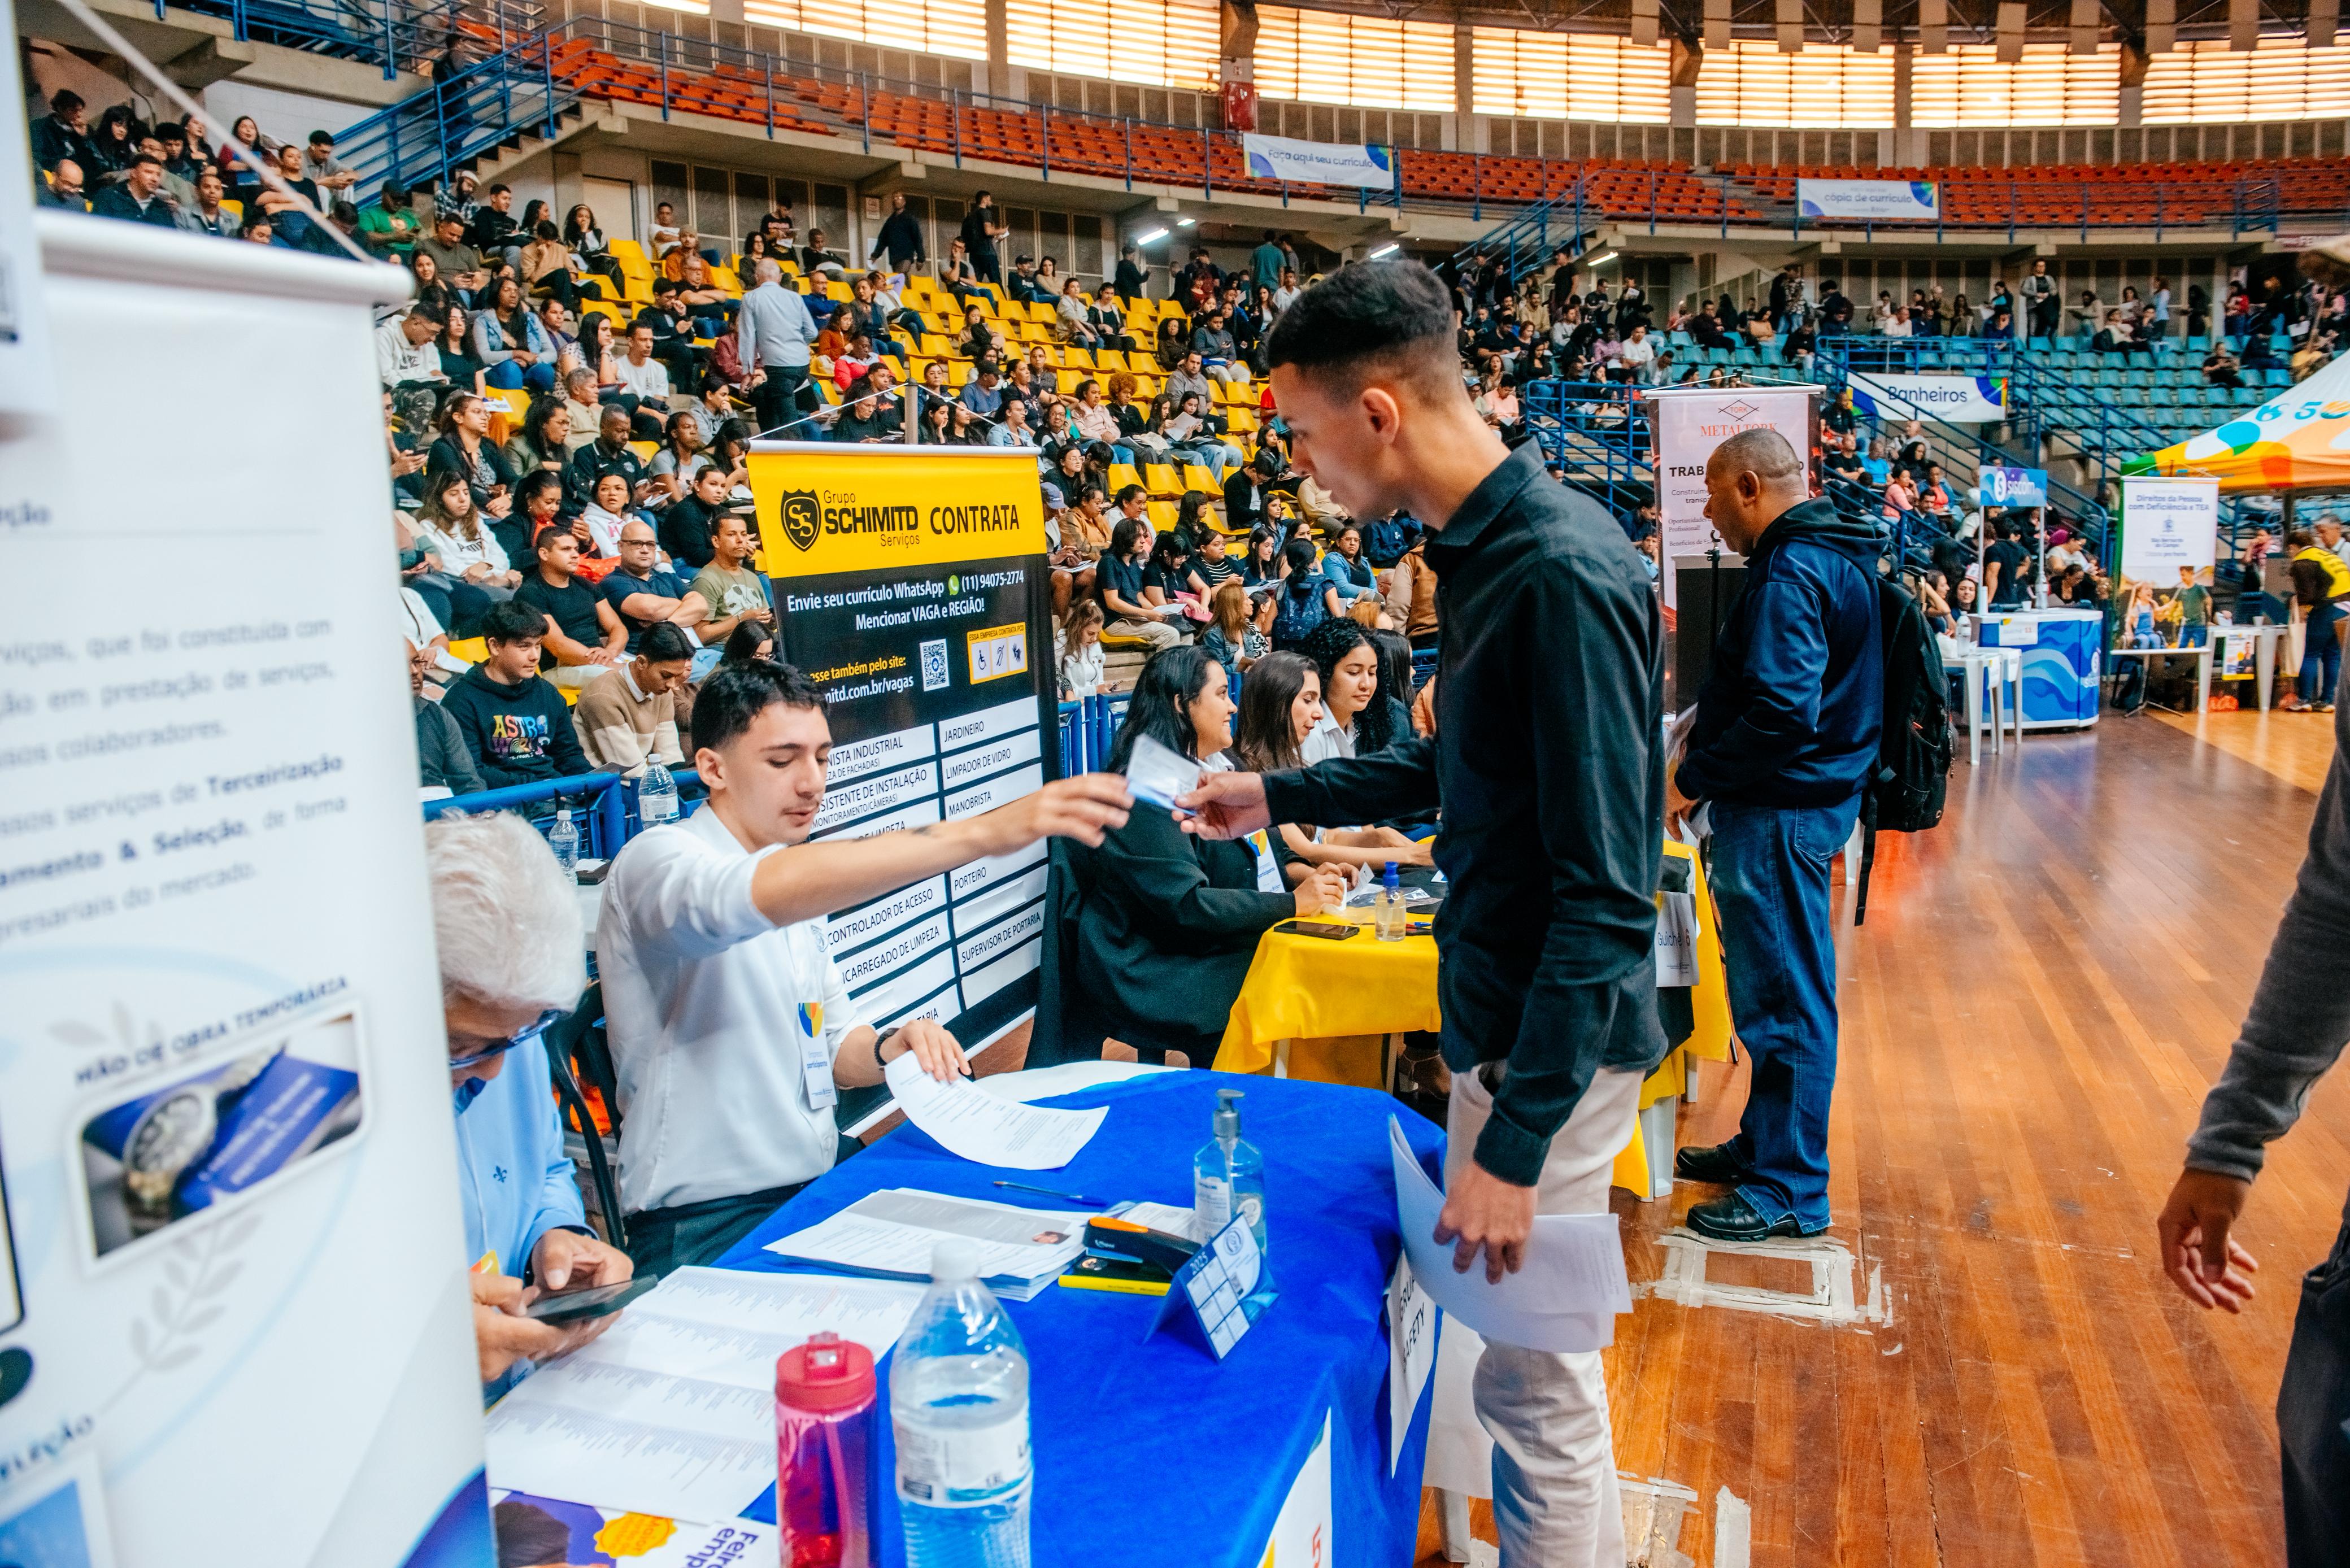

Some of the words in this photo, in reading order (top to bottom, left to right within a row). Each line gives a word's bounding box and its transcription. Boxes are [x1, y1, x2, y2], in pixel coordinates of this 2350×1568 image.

[1268, 149, 1291, 162] Faça
[1293, 153, 1314, 164] aqui
[1333, 157, 1373, 168] currículo
[1825, 193, 1852, 204] cópia
[1855, 193, 1867, 202] de
[1888, 386, 1968, 402] Banheiros
[824, 490, 856, 506] Grupo
[824, 506, 919, 535] SCHIMITD
[930, 504, 1020, 535] CONTRATA
[880, 534, 920, 548] Serviços
[787, 593, 822, 612] Envie
[824, 593, 844, 608] seu
[846, 584, 893, 605] currículo
[893, 580, 945, 599] WhatsApp
[961, 575, 979, 593] (11)
[980, 570, 1024, 589] 94075-2774
[855, 611, 911, 631] Mencionar
[912, 603, 941, 622] VAGA
[942, 608, 948, 618] e
[949, 596, 985, 617] REGIÃO!
[980, 630, 998, 639] EMPRESA
[831, 661, 868, 680] também
[869, 657, 889, 676] pelo
[889, 655, 906, 669] site:
[945, 721, 984, 742] JARDINEIRO
[853, 736, 903, 760] INDUSTRIAL
[207, 753, 343, 795] Terceirização
[838, 768, 846, 778] DE
[847, 757, 880, 774] FACHADAS)
[946, 757, 982, 779] LIMPADOR
[982, 754, 991, 767] DE
[991, 748, 1011, 763] VIDRO
[863, 786, 874, 799] DE
[876, 769, 927, 795] INSTALAÇÃO
[949, 791, 991, 816] MANOBRISTA
[954, 866, 986, 891] PORTEIRO
[828, 907, 893, 946] CONTROLADOR
[894, 901, 904, 916] DE
[905, 888, 933, 911] ACESSO
[899, 942, 909, 956] DE
[909, 926, 940, 950] LIMPEZA
[961, 933, 1002, 963] SUPERVISOR
[1003, 927, 1013, 941] DE
[1013, 912, 1041, 936] PORTARIA
[1685, 928, 1691, 947] 6
